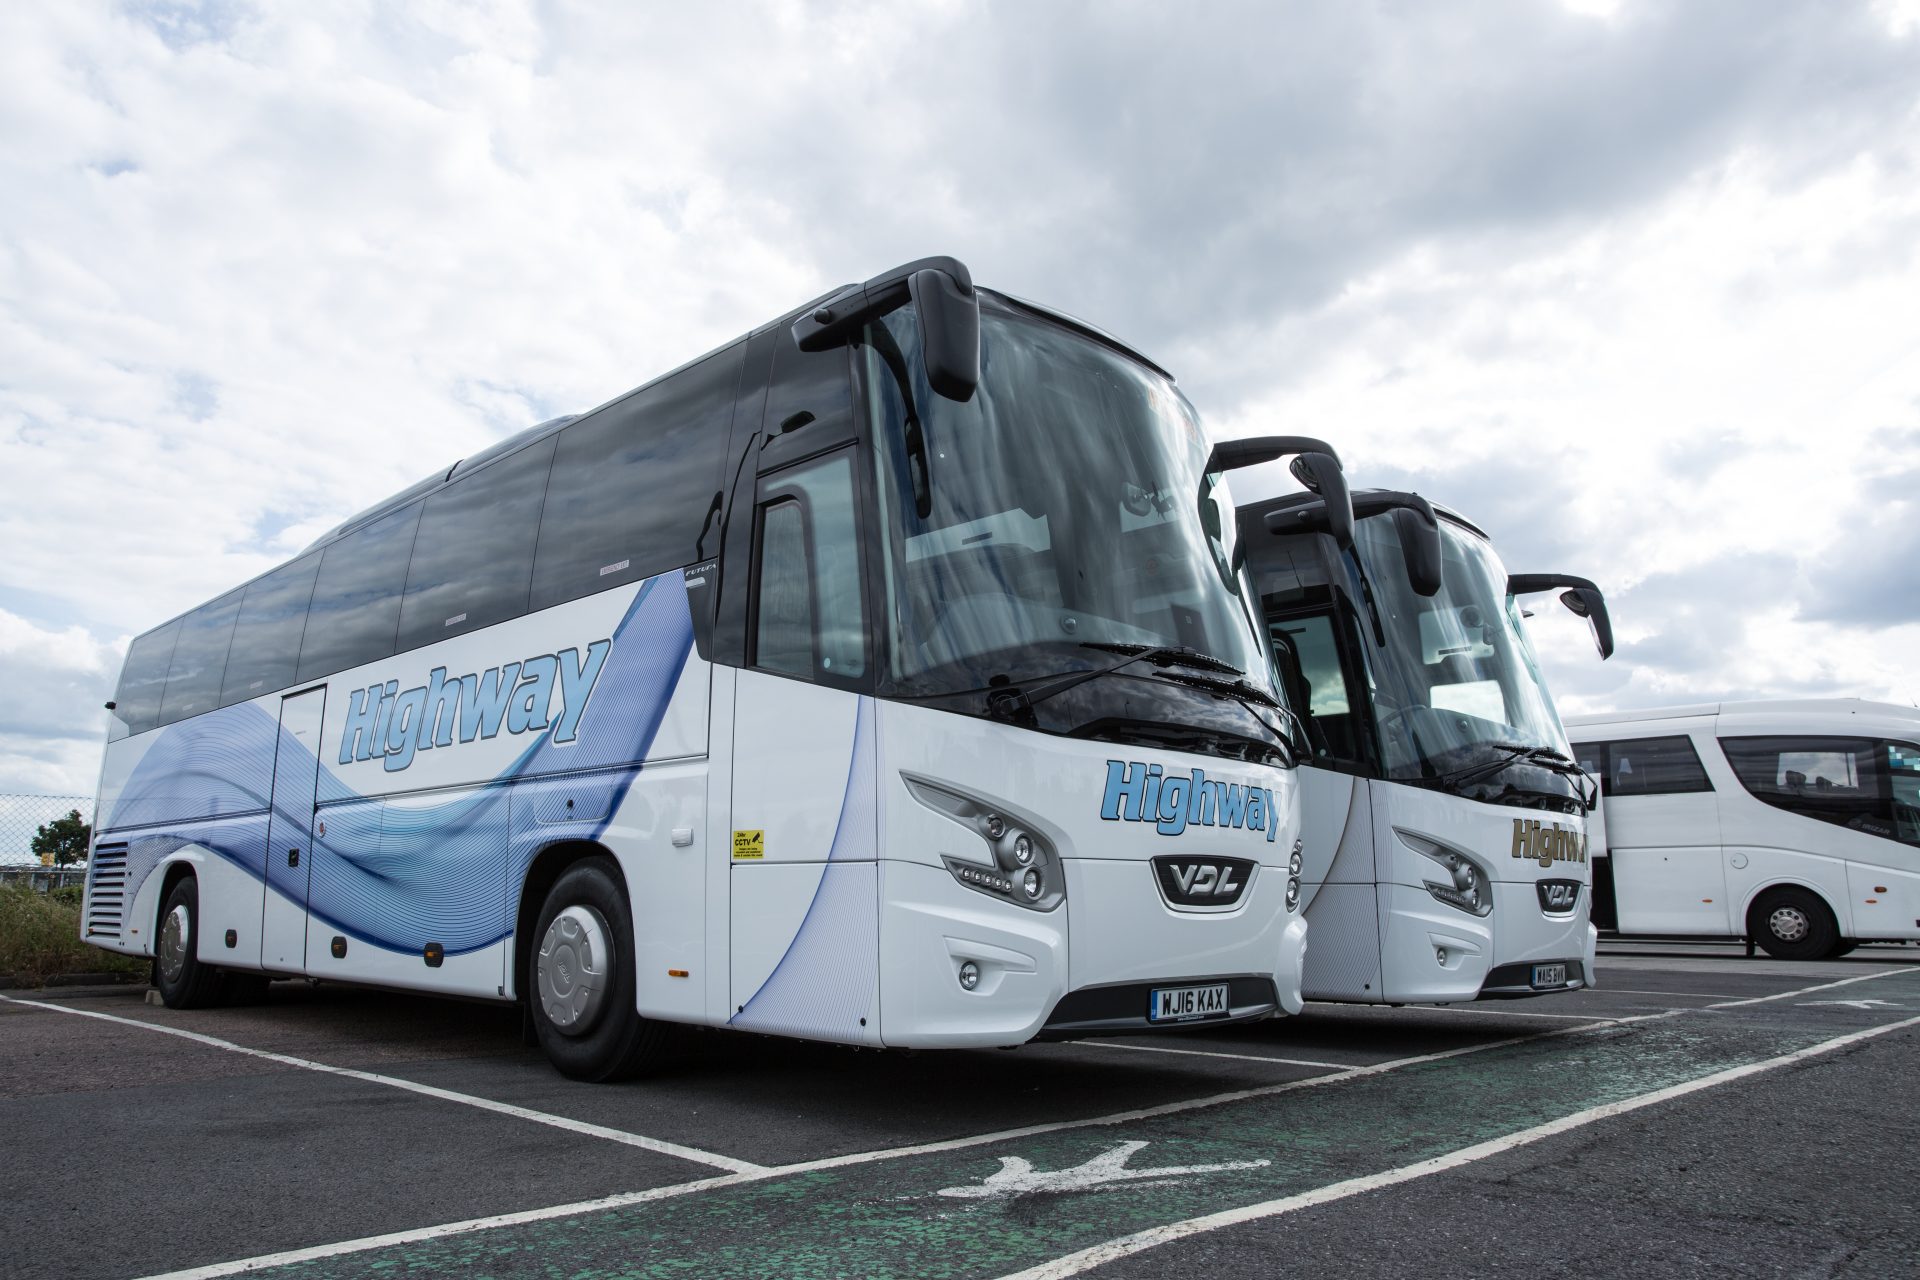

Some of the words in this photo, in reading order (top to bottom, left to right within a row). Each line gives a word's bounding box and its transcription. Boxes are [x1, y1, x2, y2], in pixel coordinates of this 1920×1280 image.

[339, 638, 612, 772] Highway
[1100, 760, 1282, 842] Highway
[1169, 864, 1238, 896] VDL
[1543, 884, 1574, 906] VDL
[1162, 991, 1194, 1015] WJ16
[1197, 988, 1223, 1012] KAX
